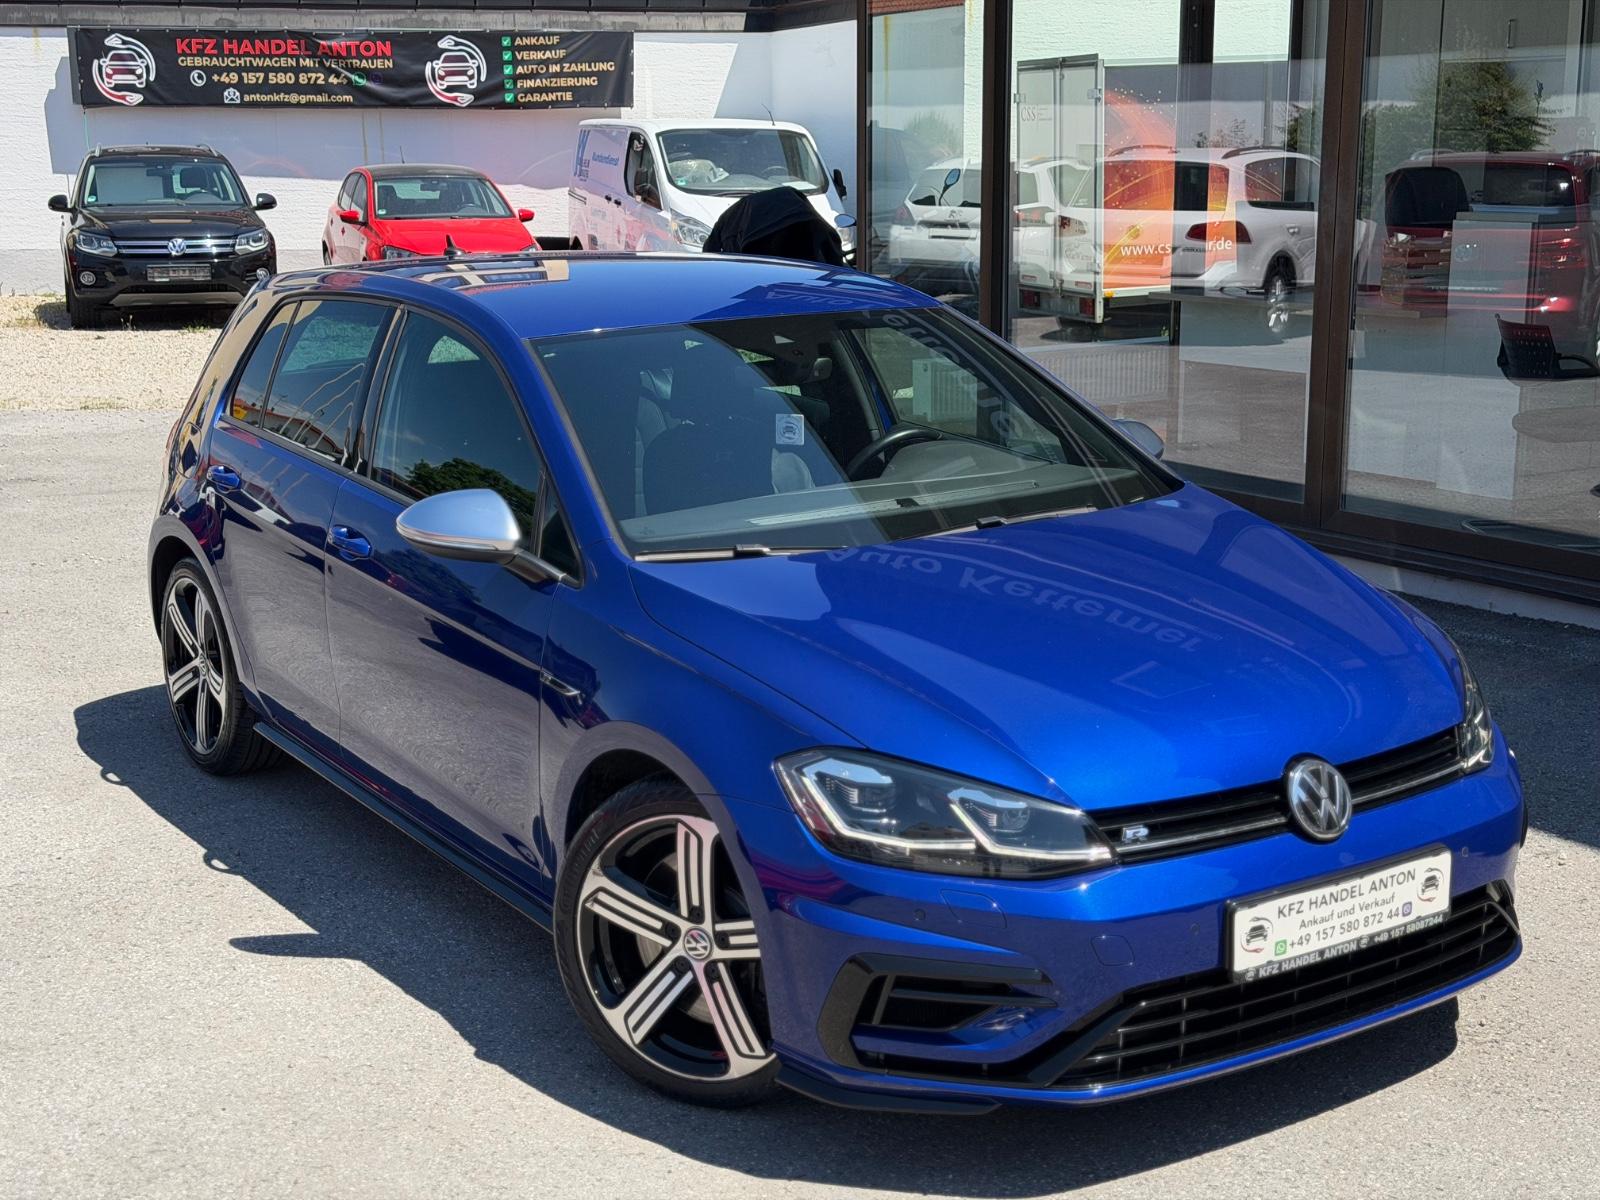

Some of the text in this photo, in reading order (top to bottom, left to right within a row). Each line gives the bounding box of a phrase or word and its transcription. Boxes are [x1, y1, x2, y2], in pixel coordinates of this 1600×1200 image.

[514, 36, 560, 46] ANKAUF
[176, 39, 392, 57] KFZ HANDEL ANTON
[515, 50, 567, 60] VERKAUF
[178, 57, 393, 68] GEBRAUCHTWAGEN MIT VERTRAUEN
[516, 62, 615, 74] AUTO IN ZAHLUNG
[211, 72, 348, 85] +49 157 580 872 44
[516, 77, 598, 88] FINANZIERUNG
[243, 93, 353, 104] antonkfz@gmail.com
[517, 92, 573, 102] GARANTIE
[1277, 867, 1416, 919] KFZ HANDEL ANTON
[1299, 891, 1396, 931] Ankauf und Verkauf
[1289, 906, 1400, 949] +49 157 580 872 44
[1258, 964, 1280, 978] KFZ
[1281, 952, 1321, 972] HANDEL
[1323, 939, 1358, 960] ANTON
